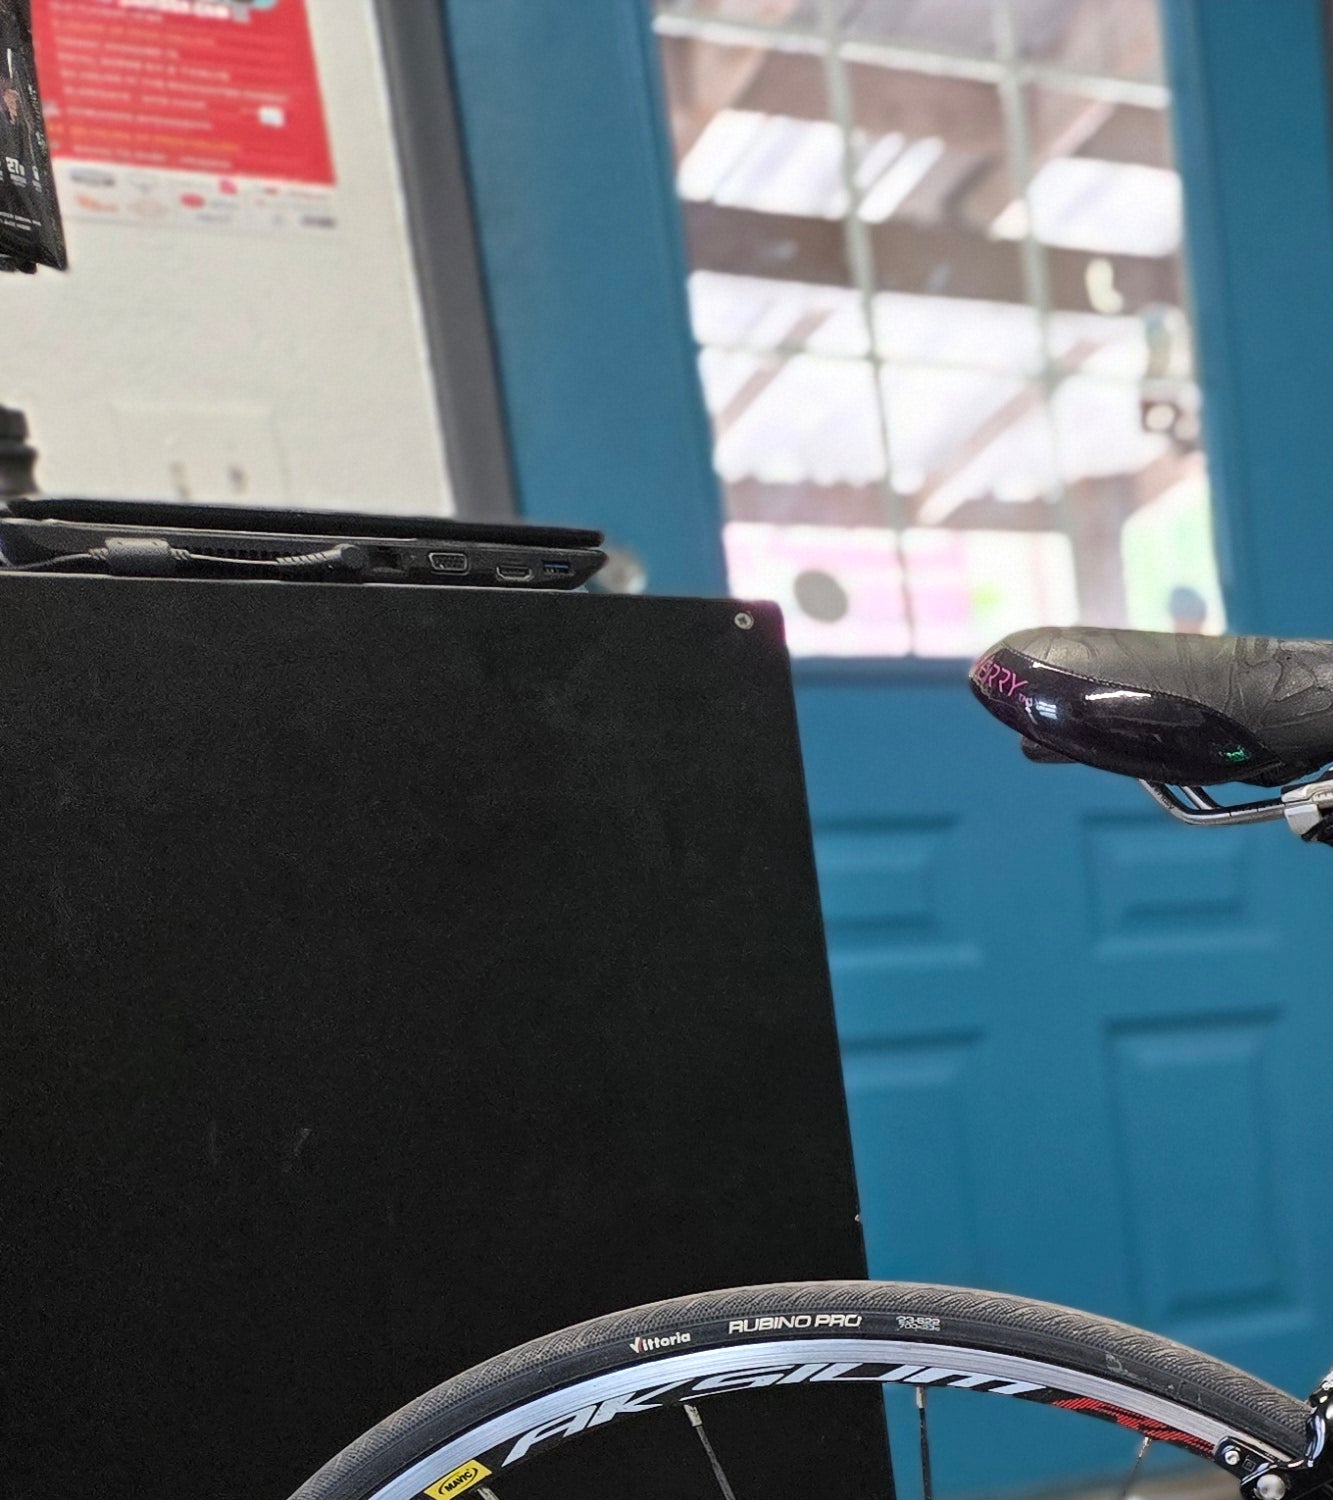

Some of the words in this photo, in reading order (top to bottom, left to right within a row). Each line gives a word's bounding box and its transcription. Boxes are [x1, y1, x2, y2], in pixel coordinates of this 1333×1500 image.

[728, 1315, 811, 1334] RUBINO
[814, 1313, 863, 1328] PRO
[630, 1331, 691, 1353] Vittoria
[500, 1362, 1048, 1468] AKSIUM
[444, 1470, 473, 1492] MAVIC
